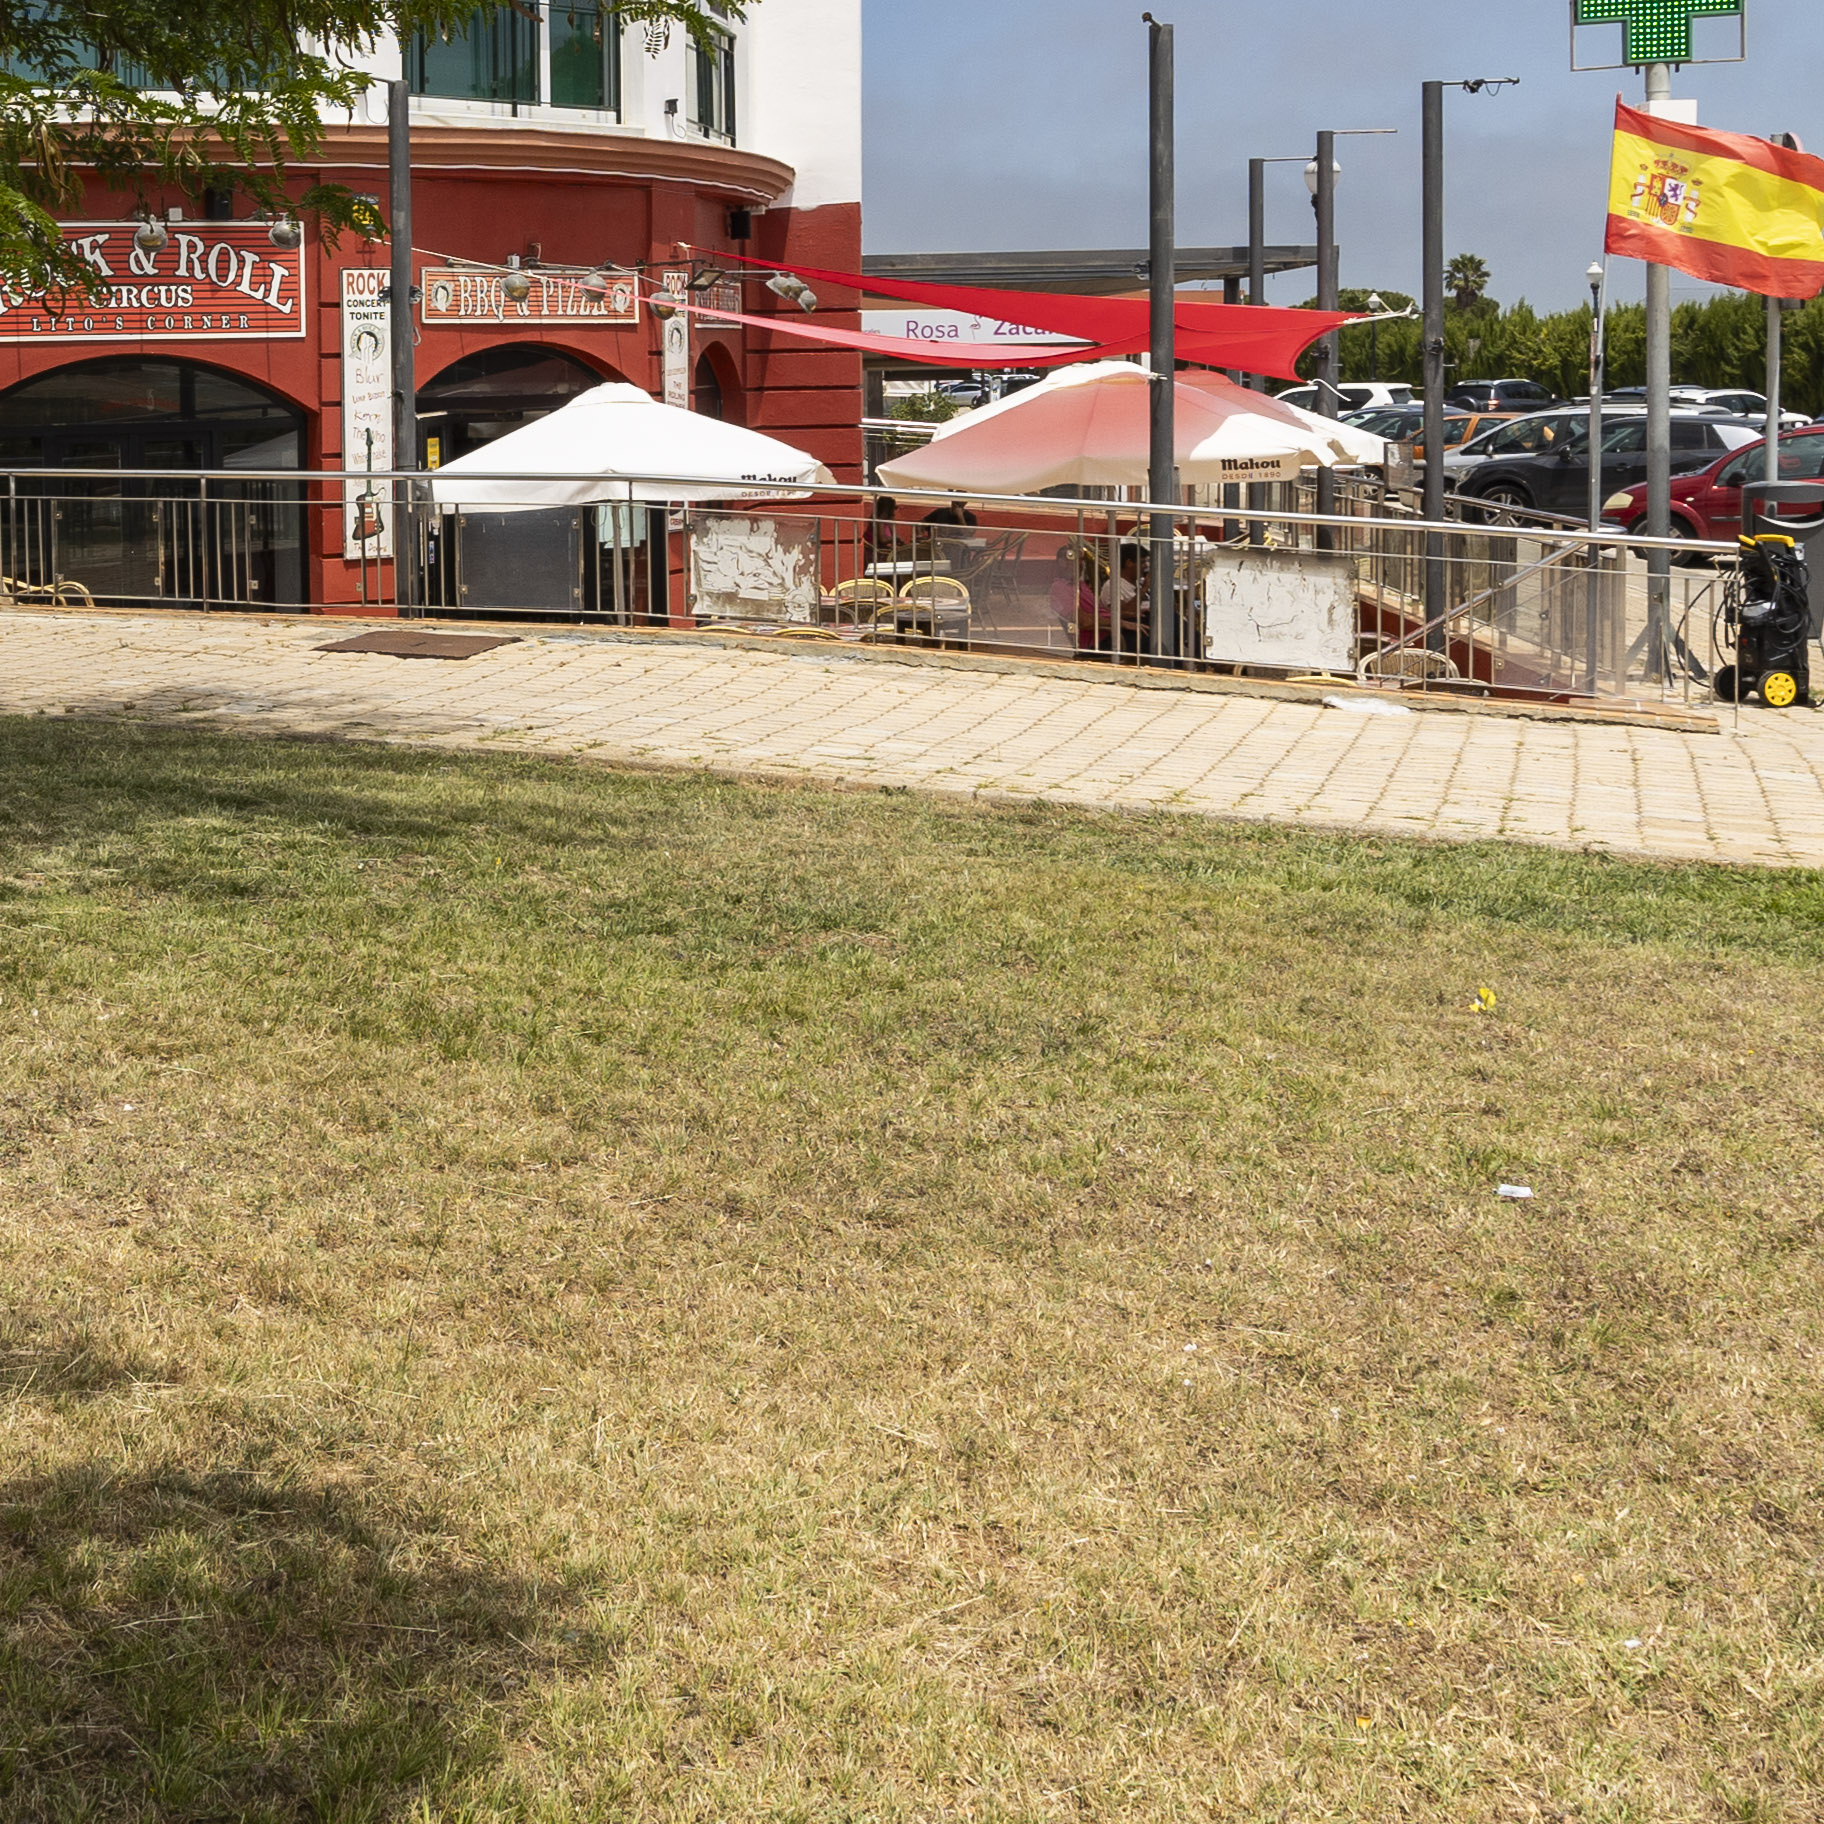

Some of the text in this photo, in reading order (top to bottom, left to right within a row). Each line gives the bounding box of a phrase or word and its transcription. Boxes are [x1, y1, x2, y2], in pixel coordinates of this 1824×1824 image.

[129, 246, 159, 275] &
[174, 233, 294, 315] ROLL
[346, 272, 386, 296] ROCK
[90, 285, 193, 309] CIRCUS
[458, 277, 505, 322] BBQ
[32, 314, 250, 333] LITO'S CORNER
[349, 311, 385, 321] TONITE
[906, 319, 1057, 339] Rosa Zaca
[1221, 458, 1280, 470] Mahou
